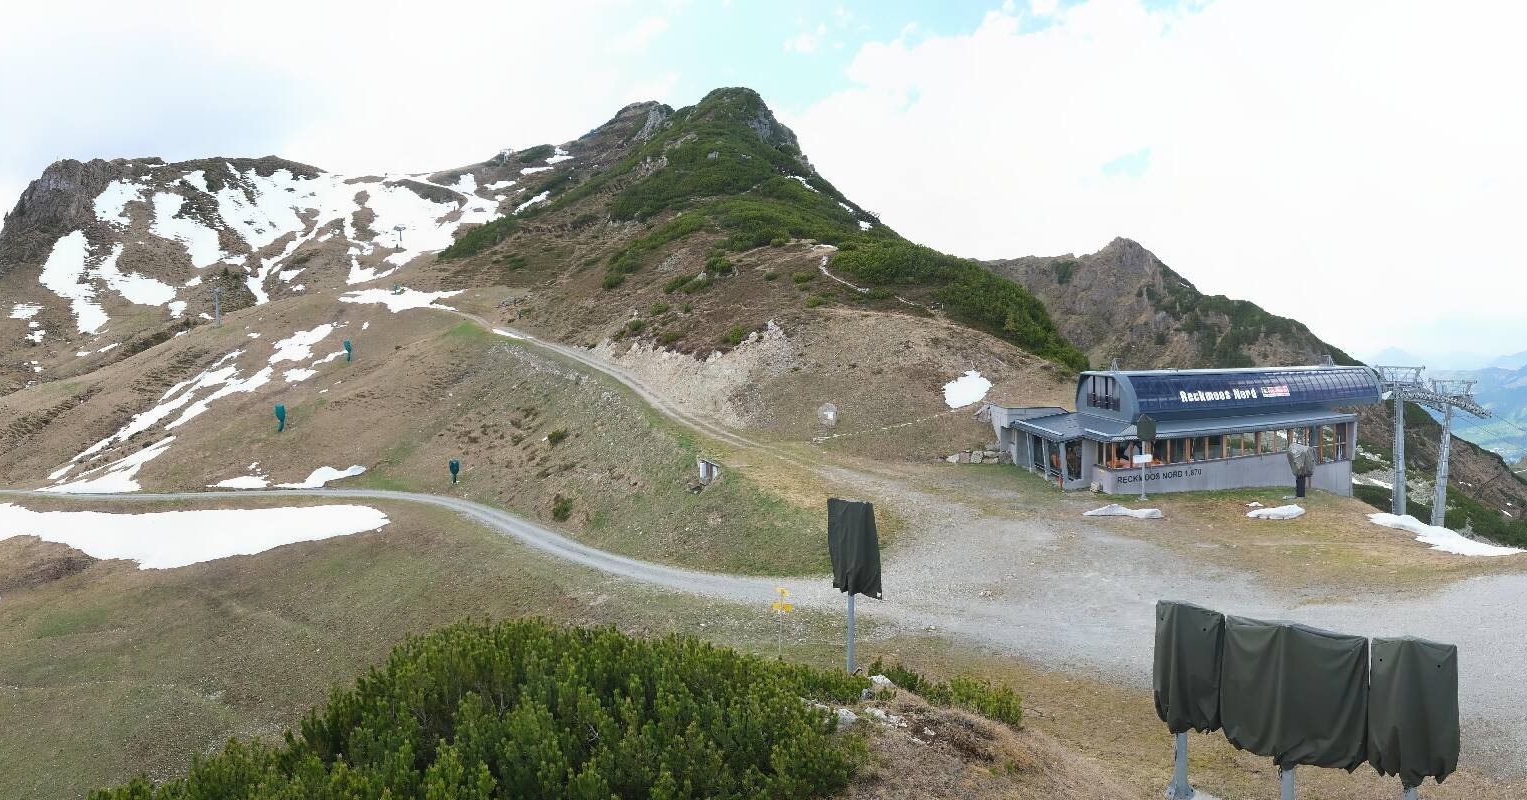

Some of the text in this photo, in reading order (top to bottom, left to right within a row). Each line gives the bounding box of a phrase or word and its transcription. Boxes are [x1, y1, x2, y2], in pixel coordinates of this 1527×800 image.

[1179, 390, 1231, 402] Reckmoos
[1232, 388, 1257, 400] Nord
[1162, 470, 1183, 480] NORD
